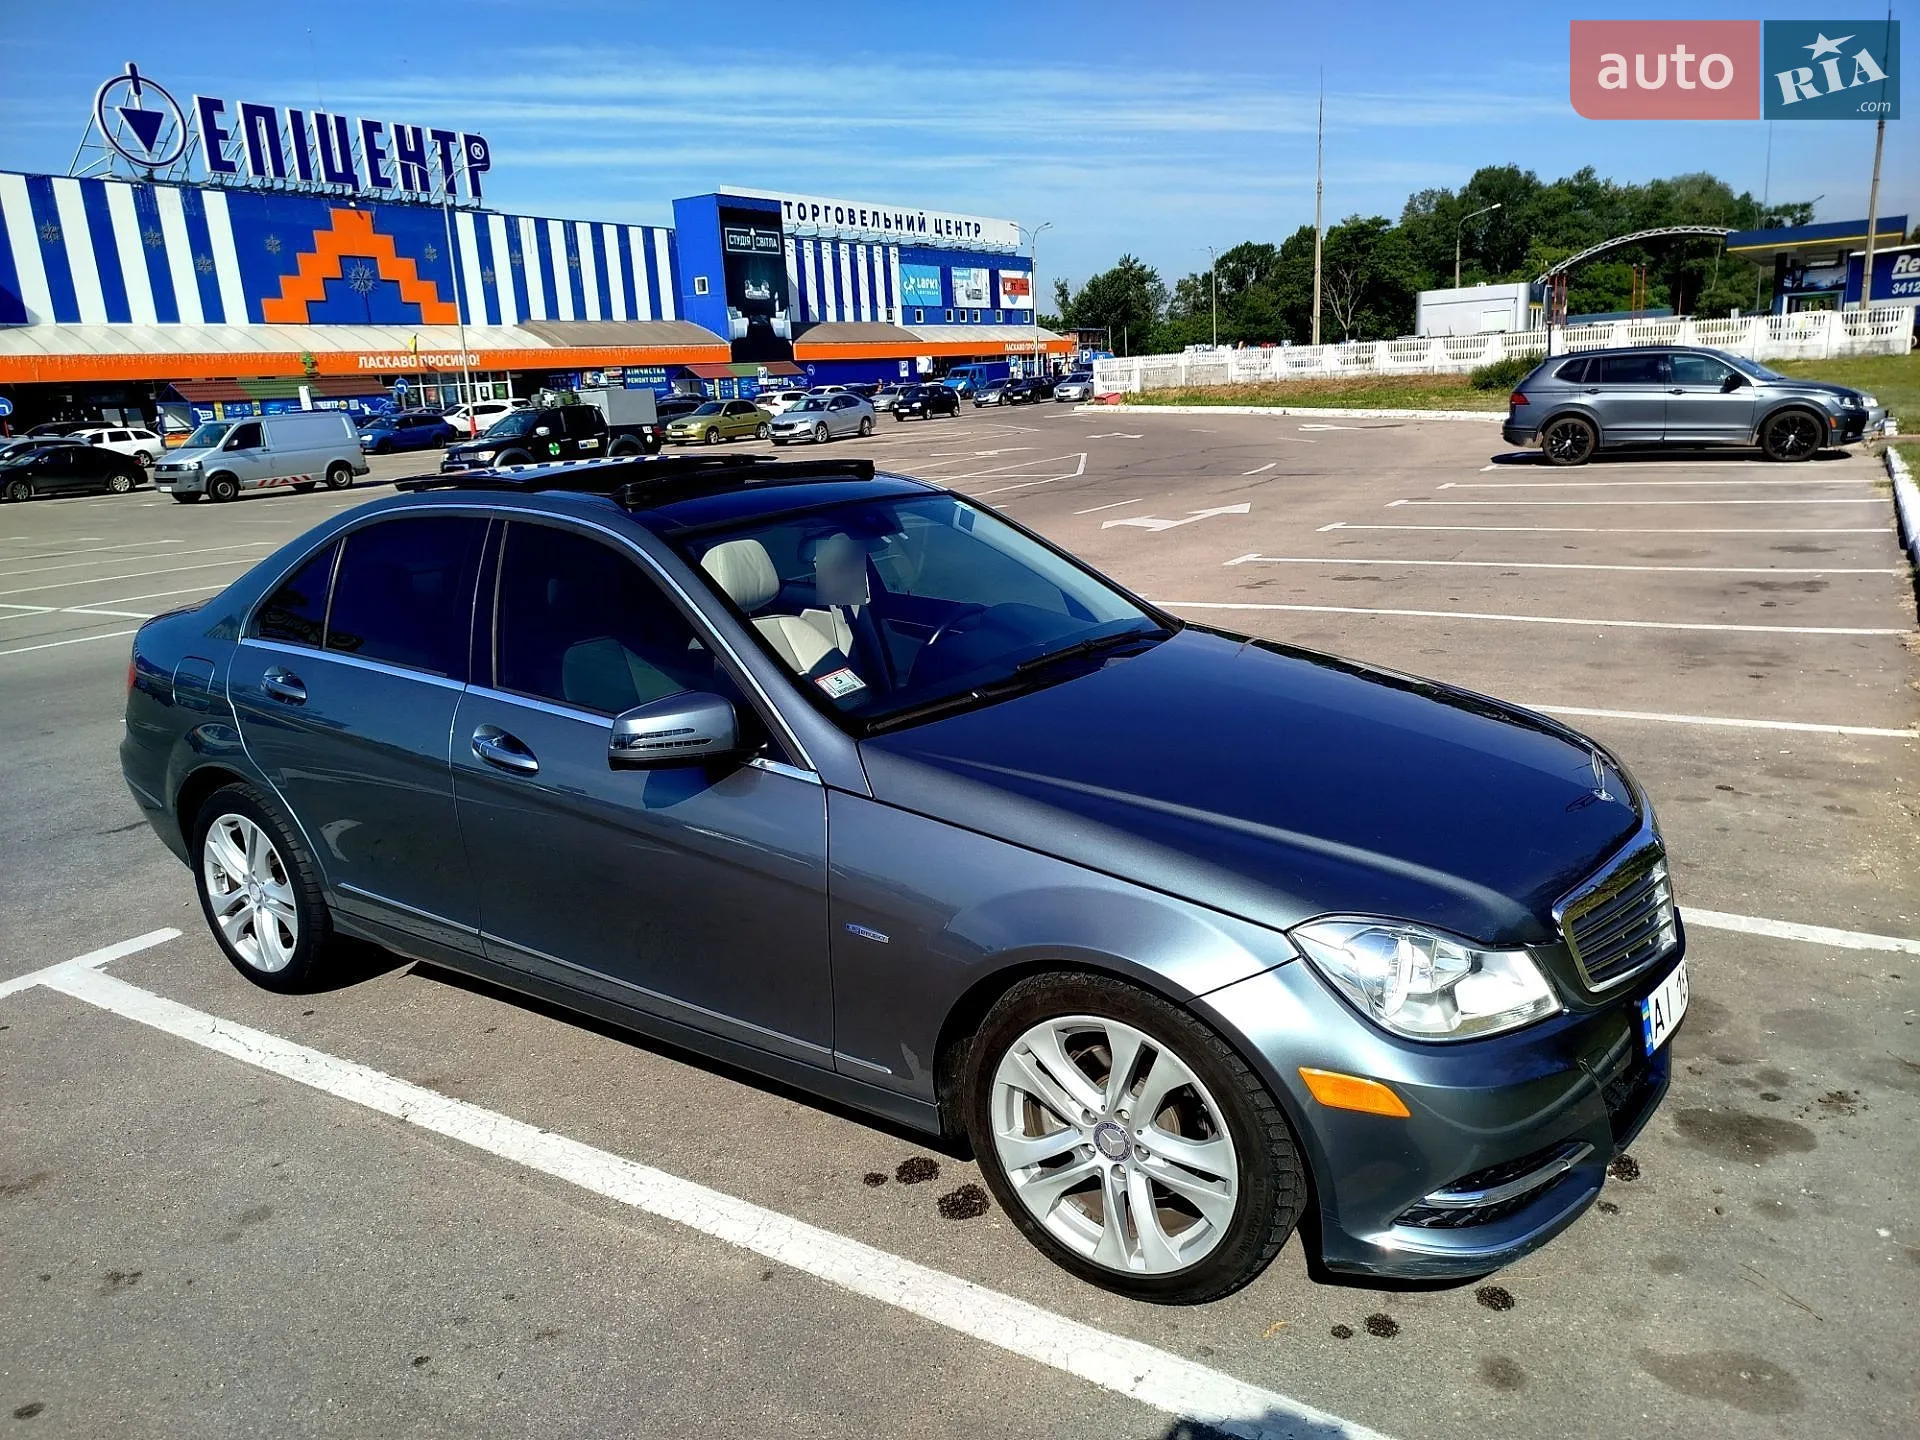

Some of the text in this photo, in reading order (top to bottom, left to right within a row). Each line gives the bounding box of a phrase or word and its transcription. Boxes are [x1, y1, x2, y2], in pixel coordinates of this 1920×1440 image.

[193, 94, 491, 199] ЕПІЦЕНТР
[783, 201, 981, 238] ТОРГОВЕЛЬНИЙ ЦЕНТР
[358, 354, 417, 368] ЛАСКАВО
[1082, 351, 1090, 362] P
